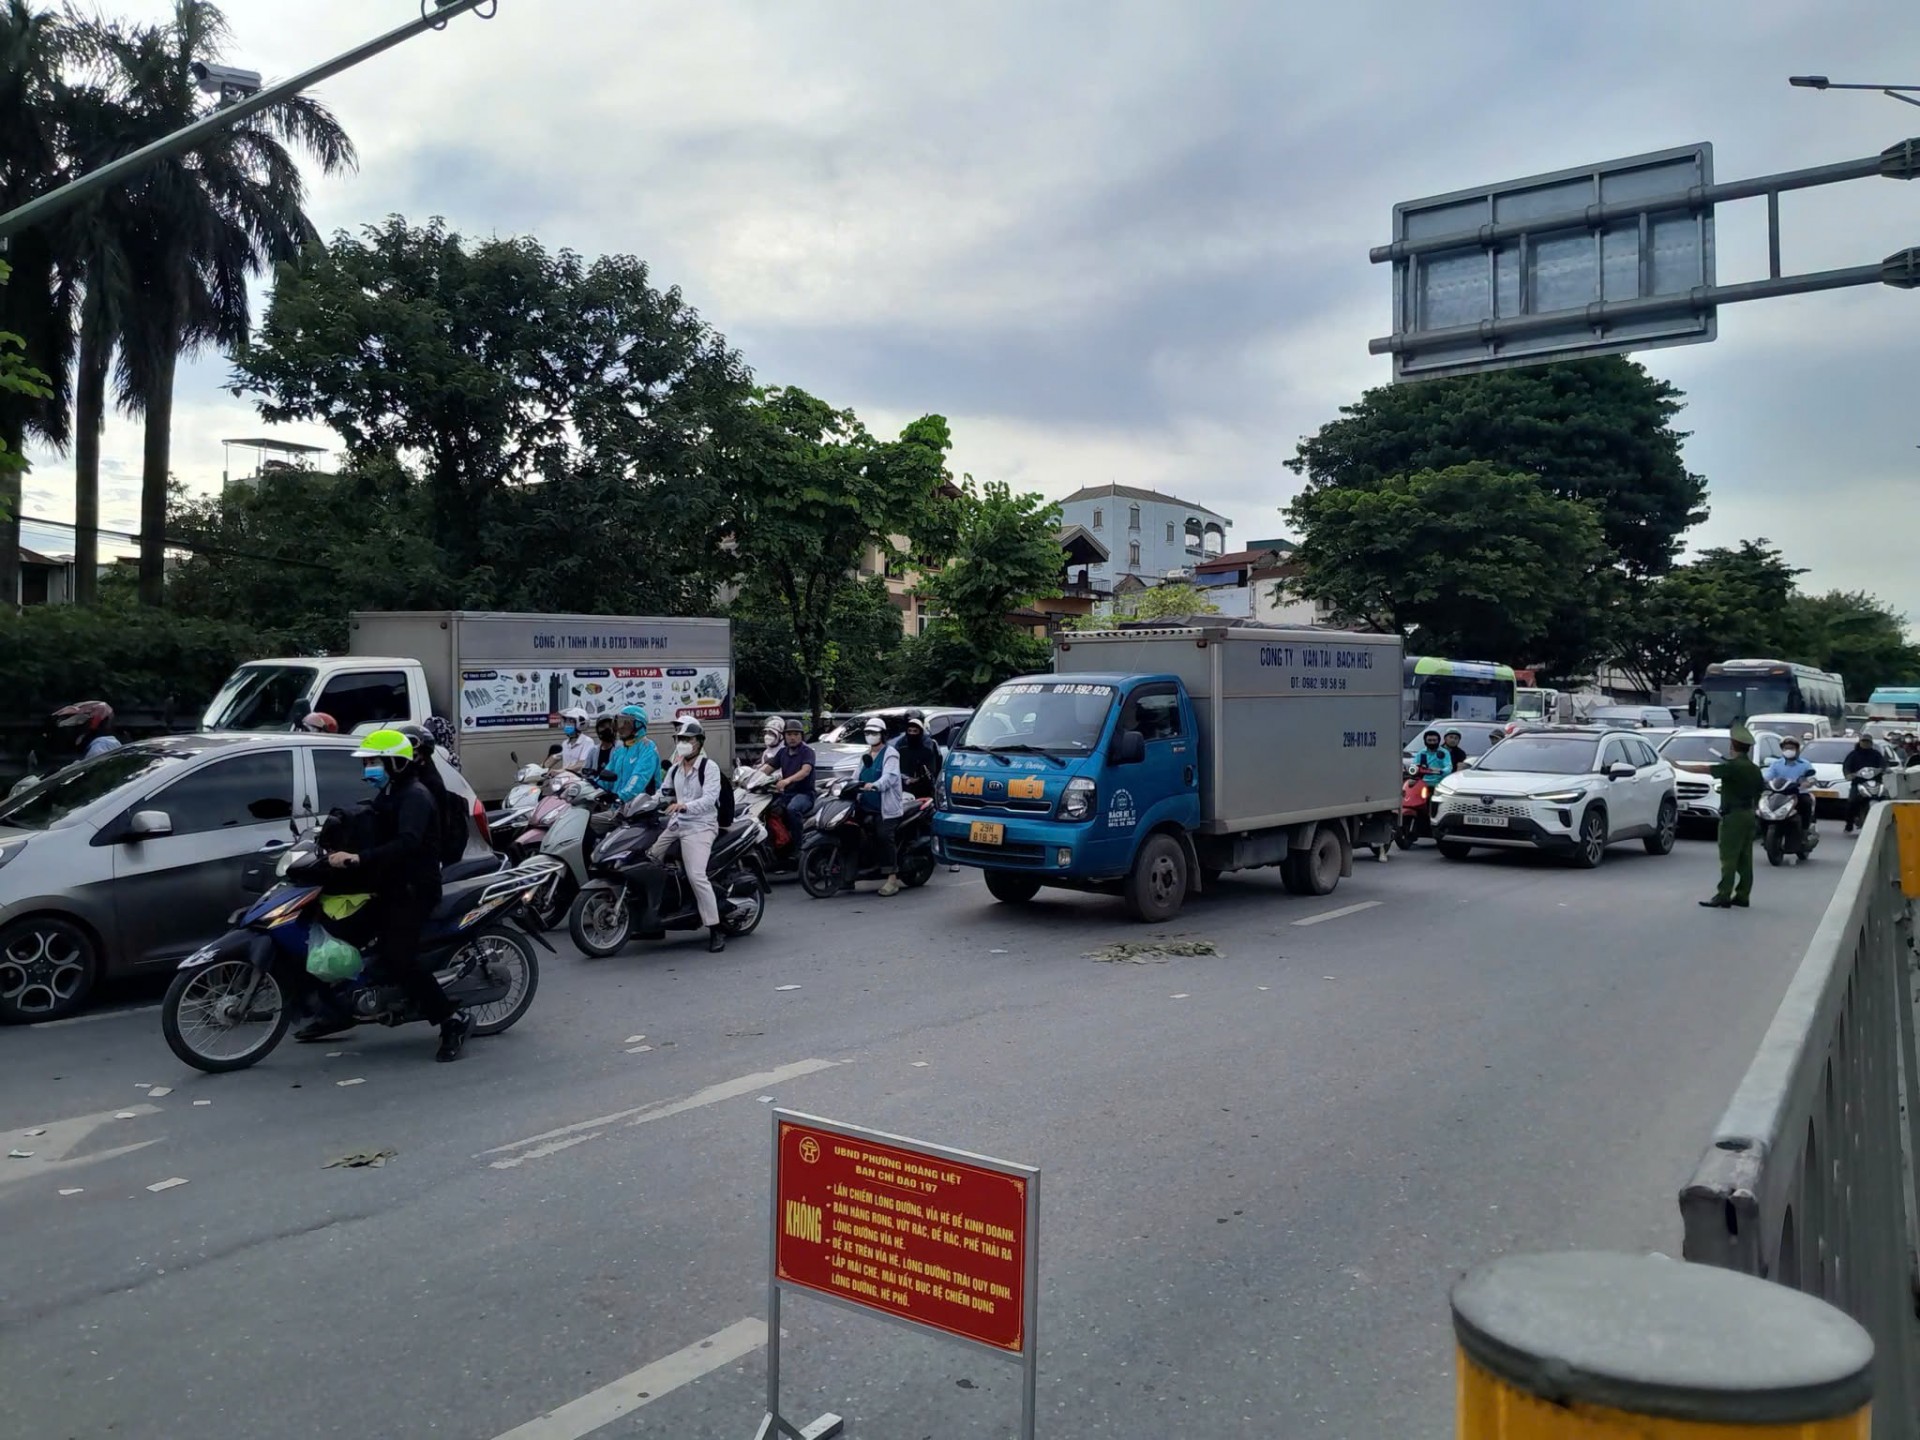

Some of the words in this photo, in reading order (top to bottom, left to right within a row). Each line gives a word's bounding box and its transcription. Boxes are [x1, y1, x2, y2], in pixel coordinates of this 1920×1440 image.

[533, 632, 555, 649] CÔNG
[1260, 643, 1283, 667] CÔNG
[1284, 648, 1294, 667] TY
[1053, 684, 1075, 694] 0913
[834, 1146, 860, 1160] UBND
[862, 1153, 902, 1170] PHƯỜNG
[904, 1163, 938, 1179] HOÀNG
[941, 1172, 962, 1185] LIỆT
[855, 1165, 876, 1178] BAN
[896, 1176, 917, 1189] ĐẠO
[920, 1182, 938, 1193] 197
[785, 1195, 822, 1244] KHÔNG
[833, 1182, 848, 1197] LẤN
[849, 1188, 873, 1204] CHIẾM
[874, 1194, 894, 1210] LÒNG
[940, 1211, 950, 1225] HÈ
[964, 1218, 984, 1234] KINH
[833, 1201, 849, 1216] BÁN
[850, 1206, 870, 1221] HÀNG
[1001, 1247, 1013, 1261] RA
[833, 1219, 852, 1234] LÒNG
[853, 1226, 879, 1243] ĐƯỜNG
[843, 1240, 853, 1253] XE
[855, 1243, 874, 1259] TRÊN
[903, 1257, 923, 1273] LÒNG
[924, 1263, 951, 1282] ĐƯỜNG
[952, 1271, 971, 1288] TRÁI
[972, 1278, 988, 1293] QUY
[831, 1273, 851, 1289] LÒNG
[945, 1289, 970, 1307] CHIẾM
